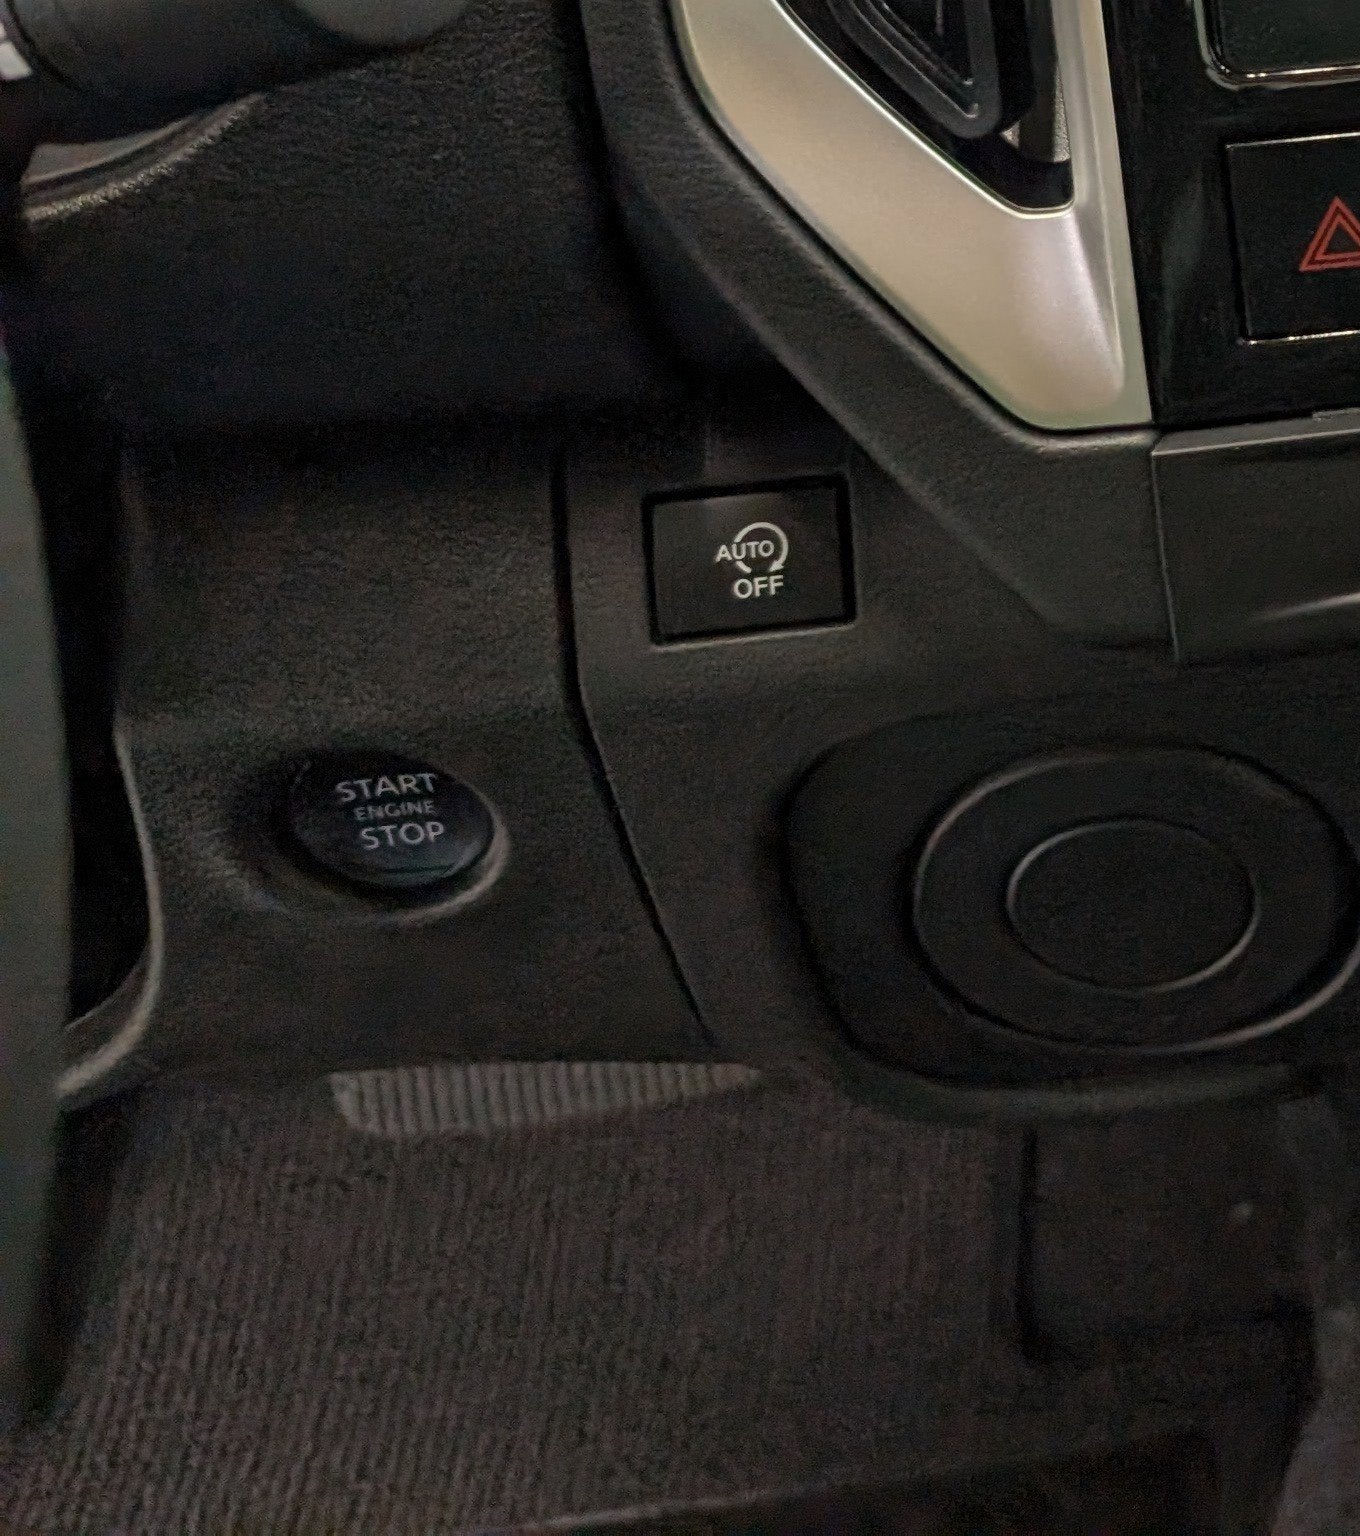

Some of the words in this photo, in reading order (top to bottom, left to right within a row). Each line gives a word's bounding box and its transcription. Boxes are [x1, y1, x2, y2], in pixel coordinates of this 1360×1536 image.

[715, 537, 776, 564] AUTO
[733, 573, 784, 601] OFF
[334, 772, 438, 806] START
[353, 799, 436, 823] ENGINE
[360, 820, 446, 851] STOP
